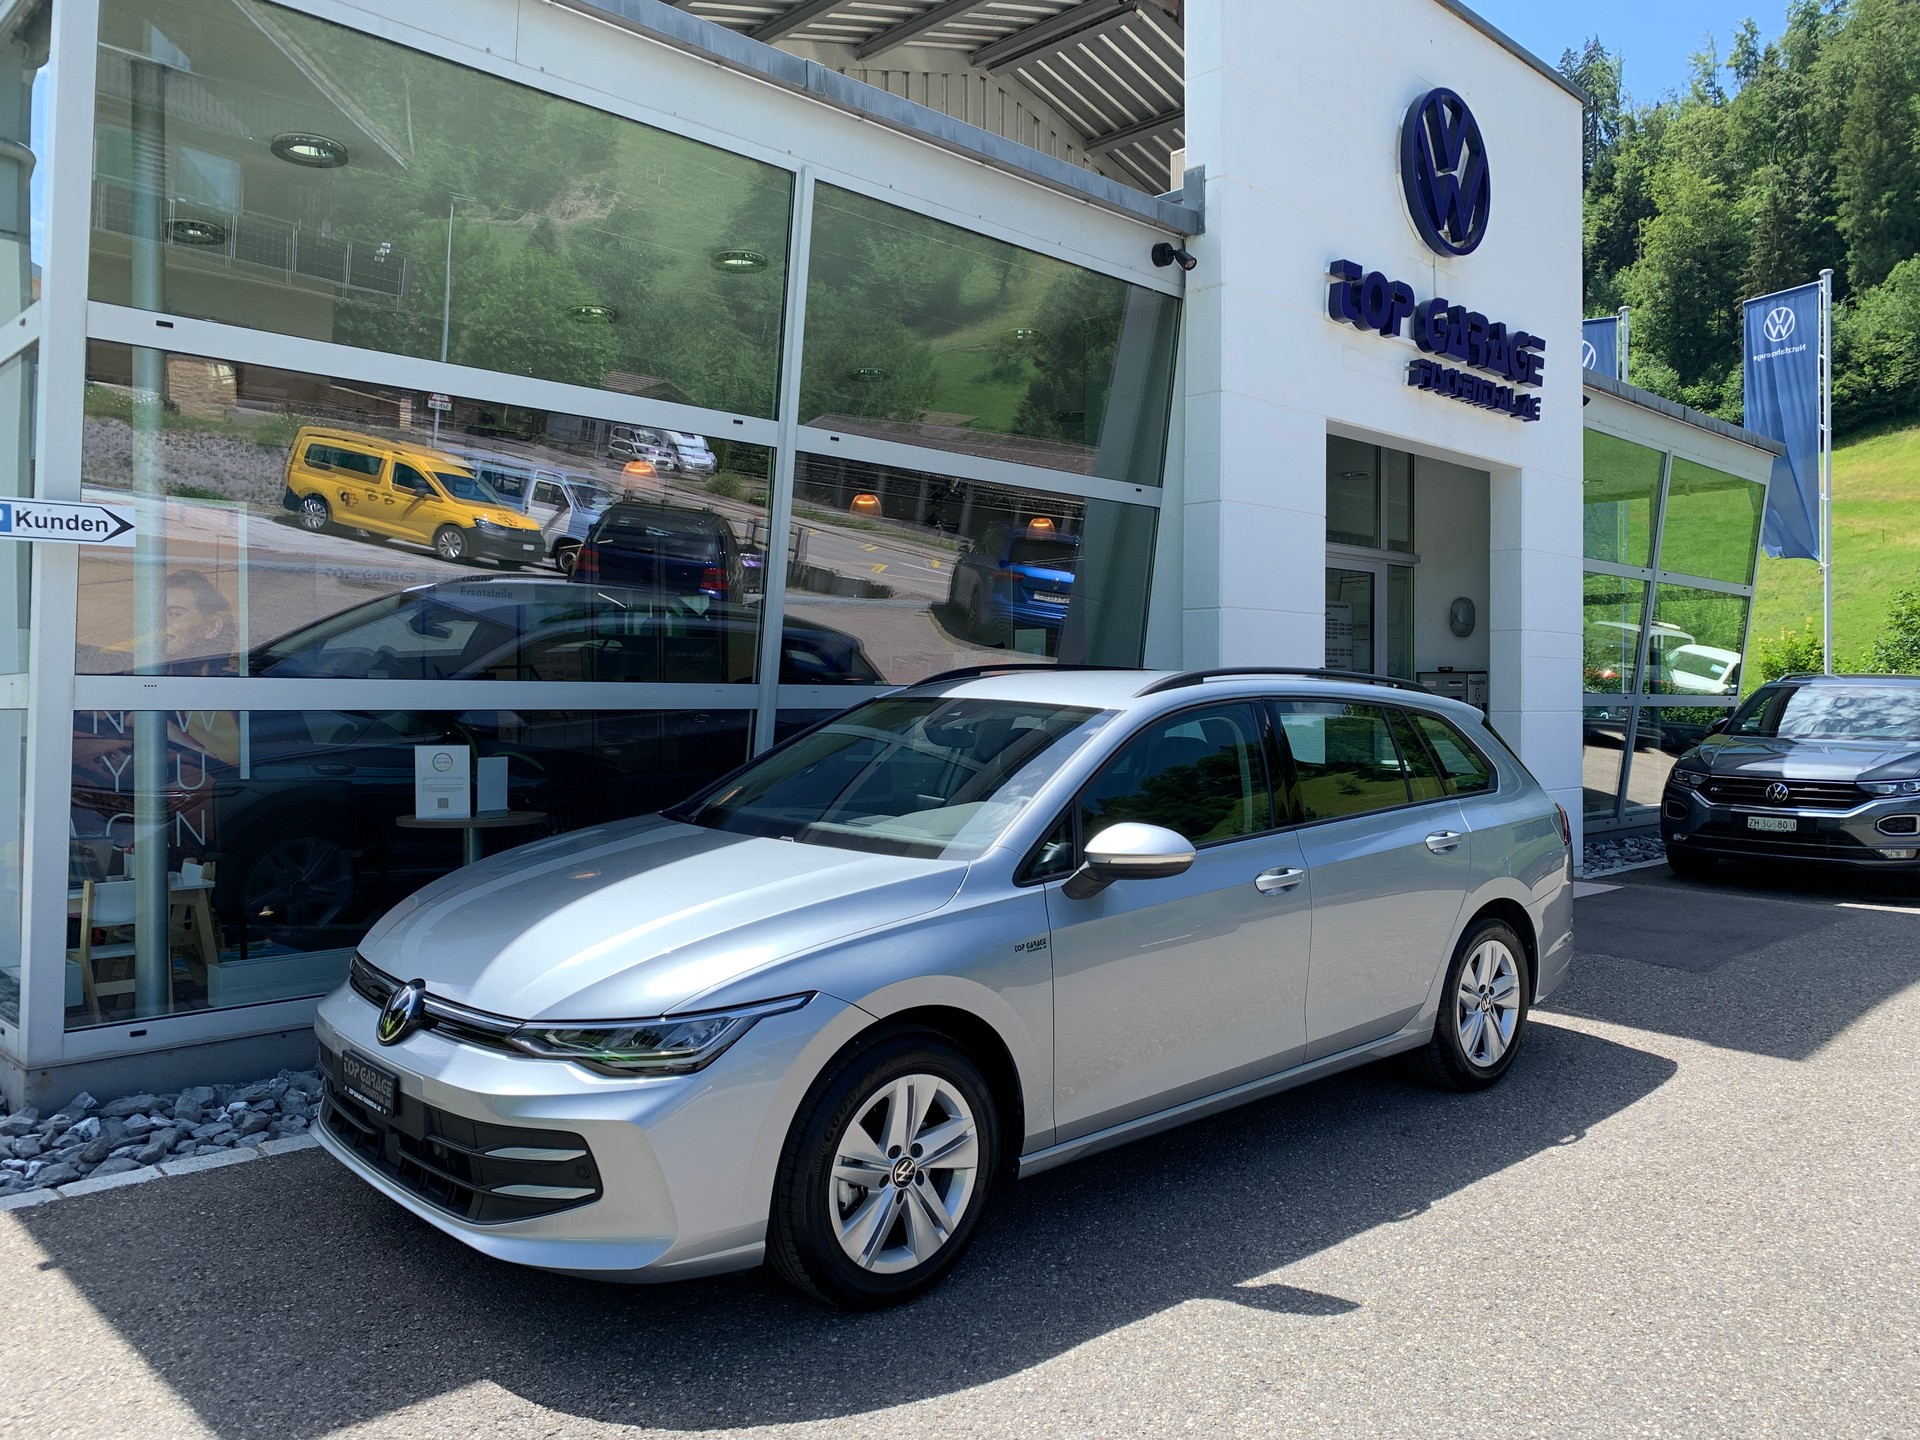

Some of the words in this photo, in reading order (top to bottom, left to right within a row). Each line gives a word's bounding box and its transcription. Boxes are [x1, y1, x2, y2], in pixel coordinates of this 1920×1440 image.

[1328, 259, 1415, 338] TOP
[1414, 298, 1546, 388] GARAGE
[15, 510, 109, 533] Kunden
[460, 587, 513, 599] Ersatzteile
[343, 1056, 360, 1078] TOP
[360, 1066, 393, 1098] GARAGE
